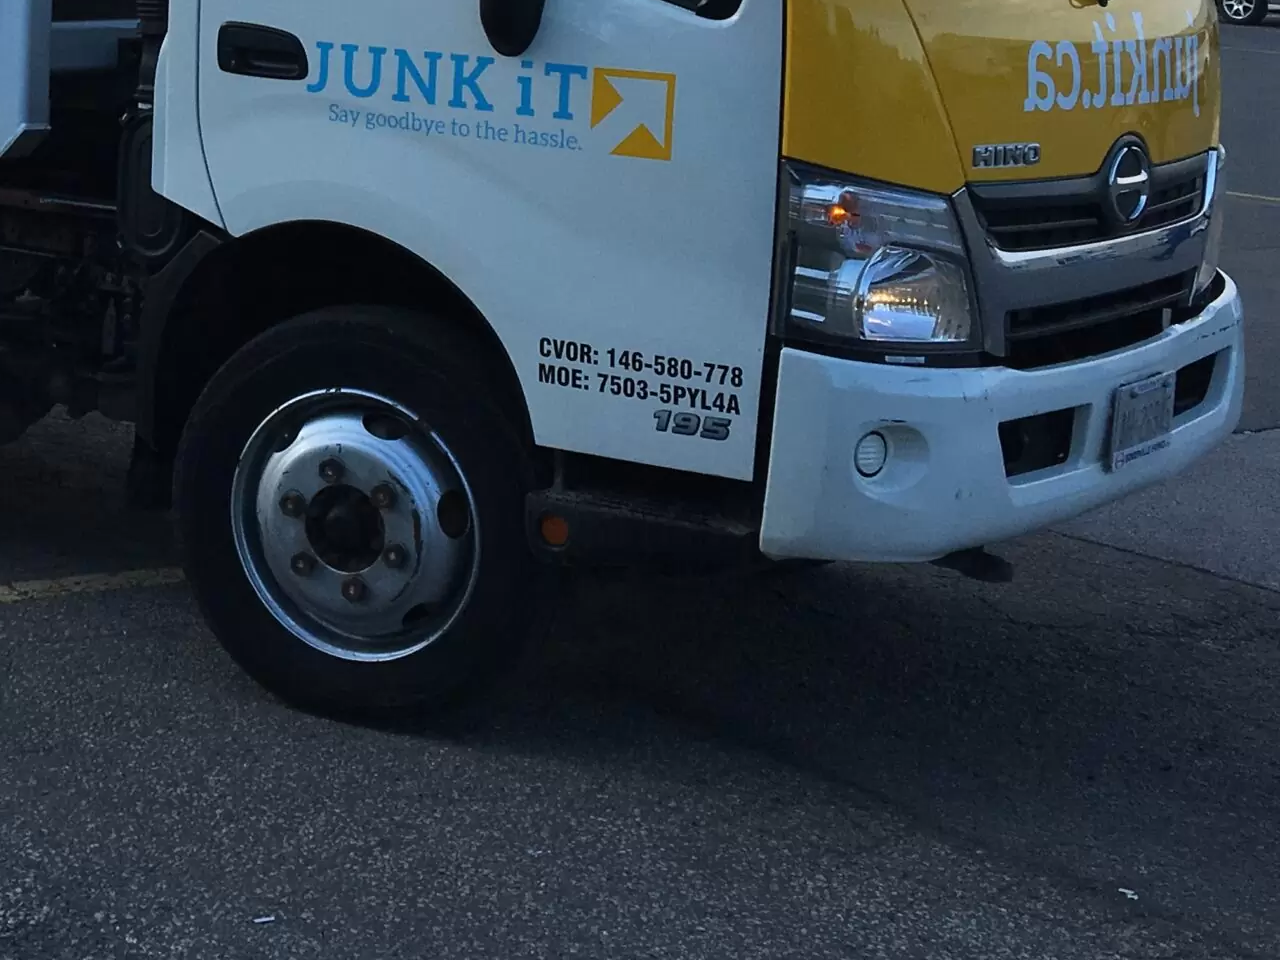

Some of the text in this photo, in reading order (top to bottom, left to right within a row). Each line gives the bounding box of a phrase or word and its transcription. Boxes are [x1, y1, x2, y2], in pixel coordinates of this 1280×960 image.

[306, 41, 495, 112] JUNK
[328, 104, 583, 151] Say goodbye to the hassle.
[972, 142, 1041, 168] HINO
[539, 337, 744, 388] CVOR: 146-580-778
[538, 363, 740, 415] MOE: 7503-5PYL4A
[653, 409, 732, 441] 195
